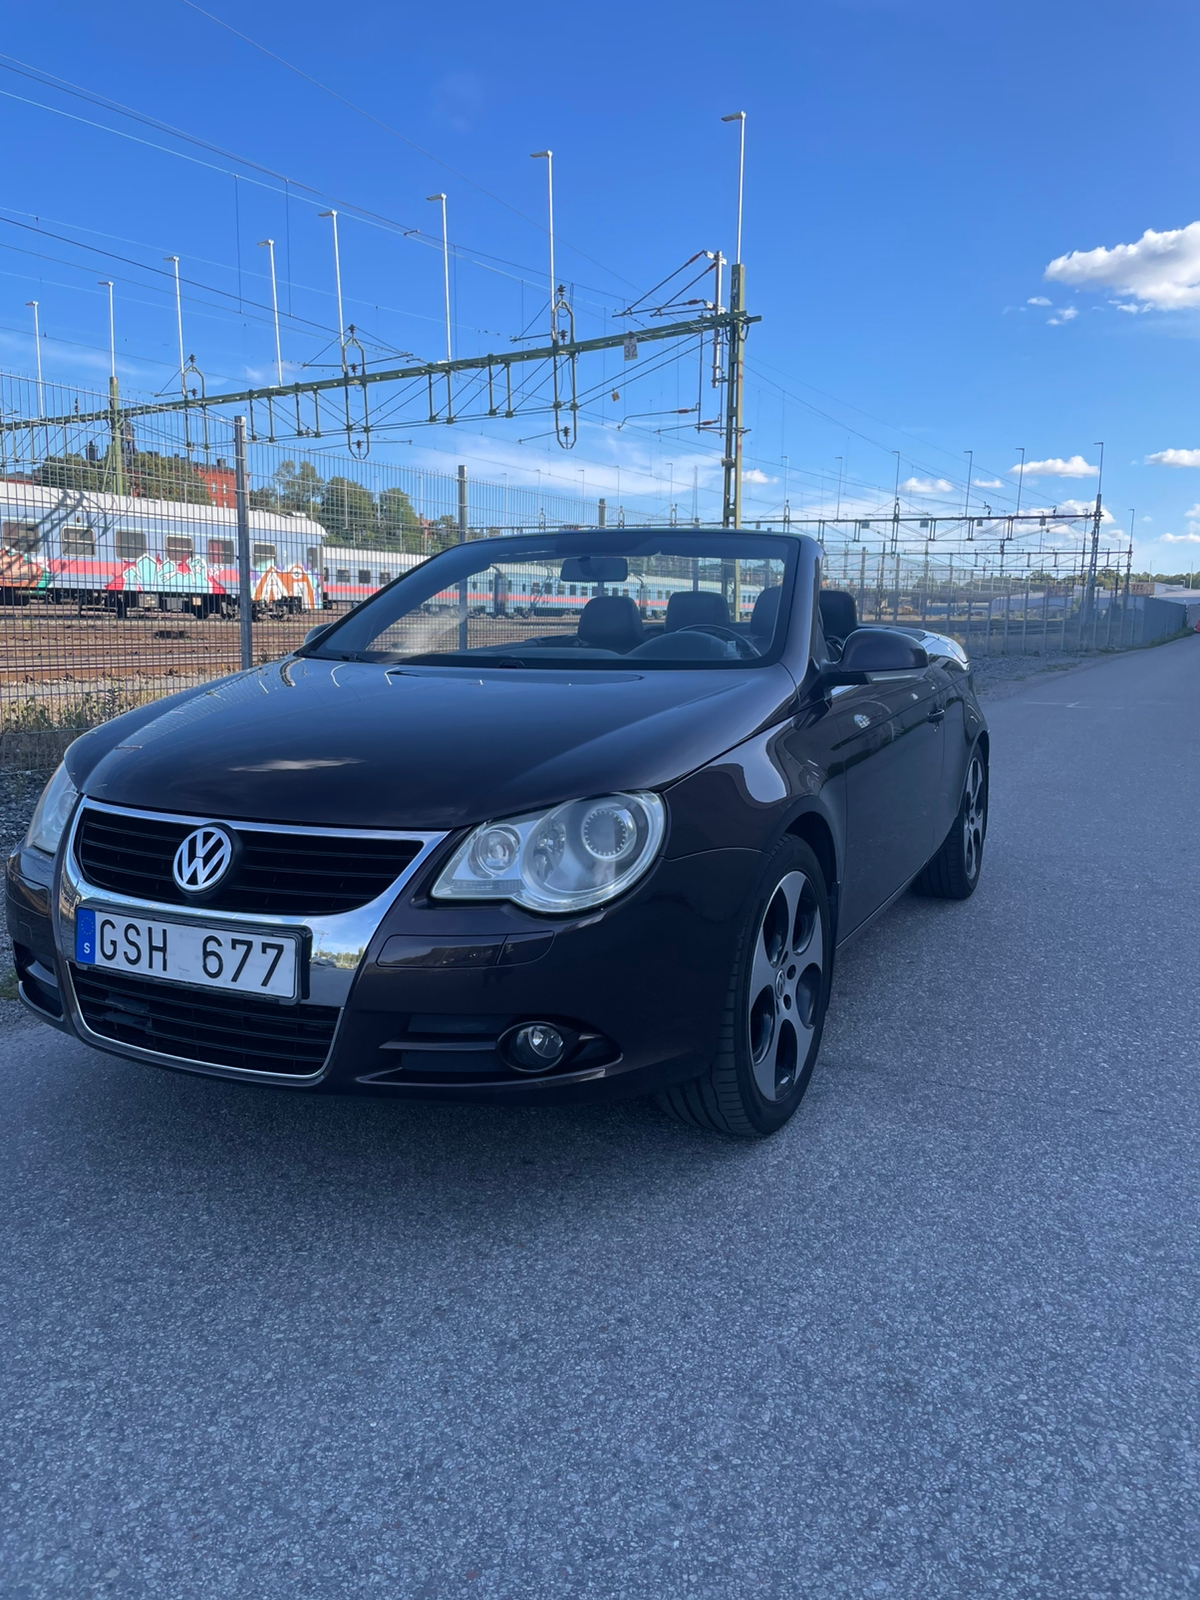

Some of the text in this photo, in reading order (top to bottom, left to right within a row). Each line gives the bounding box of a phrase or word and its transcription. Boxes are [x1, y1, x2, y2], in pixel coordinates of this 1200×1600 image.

[624, 344, 638, 358] 32
[173, 826, 231, 891] VW
[83, 942, 91, 954] S
[100, 918, 285, 987] GSH 677
